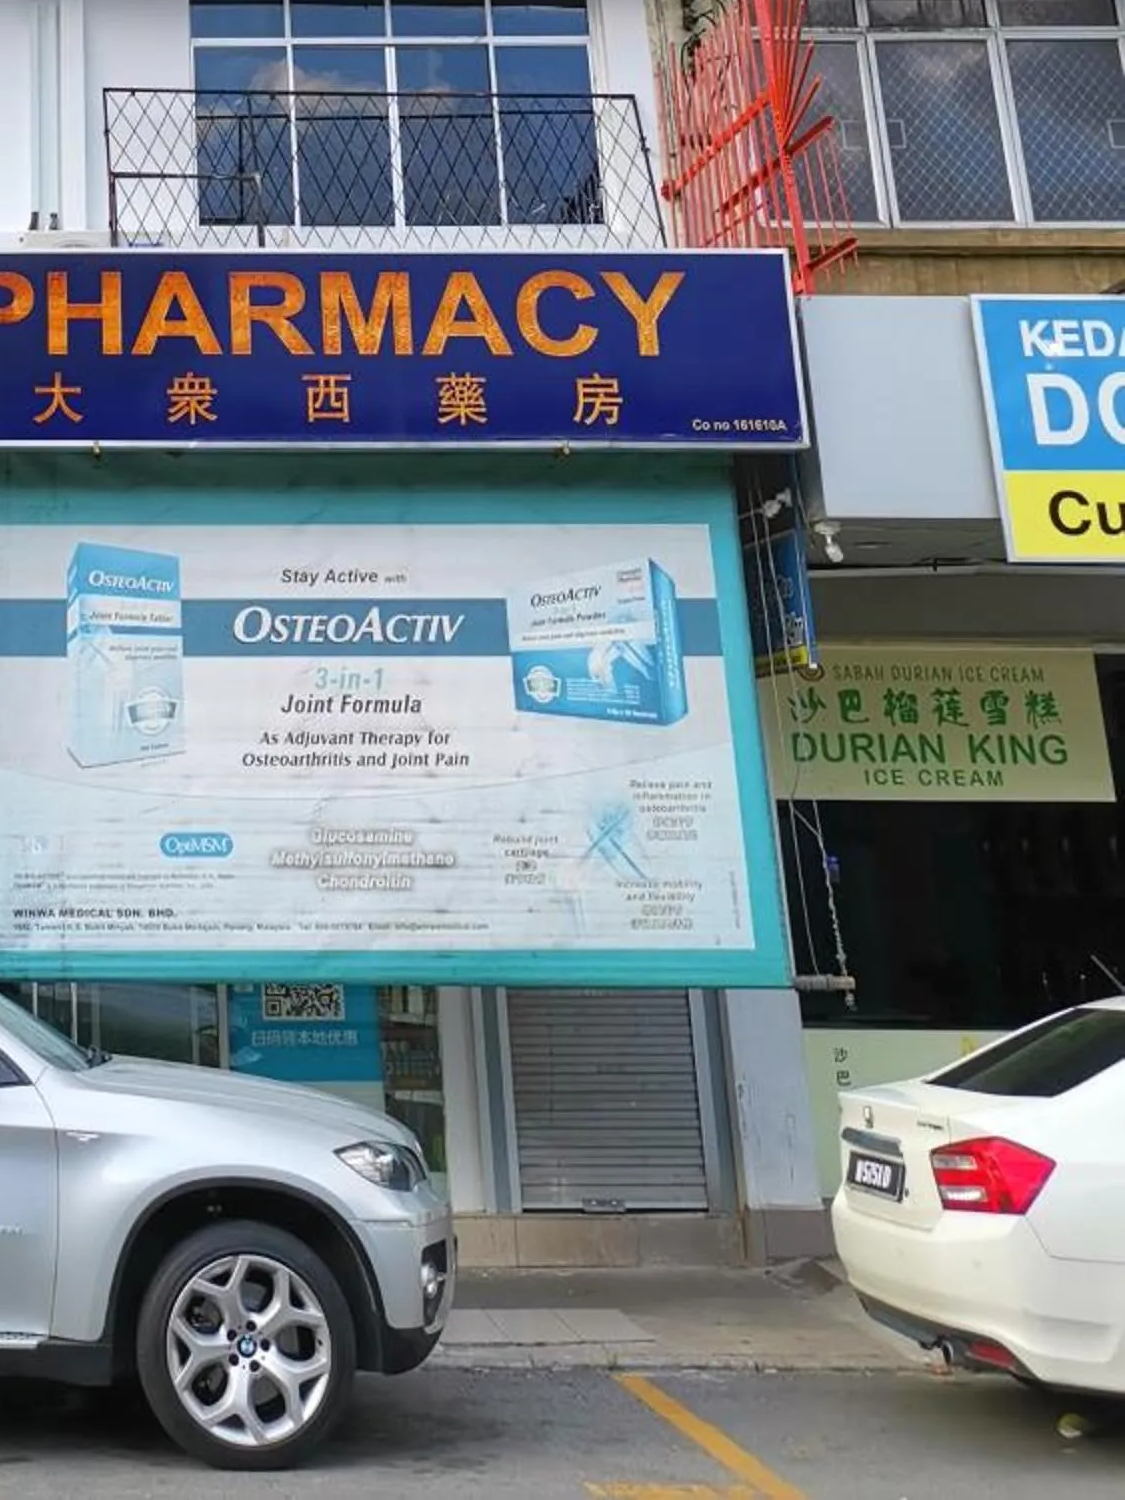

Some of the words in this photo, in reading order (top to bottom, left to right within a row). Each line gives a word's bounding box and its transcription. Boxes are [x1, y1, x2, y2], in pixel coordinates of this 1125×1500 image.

[1019, 319, 1125, 358] KED
[691, 417, 711, 432] Co
[714, 420, 730, 432] no
[281, 569, 319, 587] Stay
[324, 568, 379, 584] Active
[314, 666, 385, 691] 3-in-1
[832, 664, 884, 682] SABAH
[890, 664, 953, 683] DURIAN
[959, 665, 985, 682] ICE
[989, 665, 1045, 684] CREAM
[280, 694, 334, 714] Joint
[339, 694, 423, 714] Formula
[259, 731, 279, 746] As
[283, 730, 355, 748] Adjuvant
[359, 731, 423, 749] Therapy
[427, 729, 451, 746] for
[791, 731, 947, 764] DURIAN
[967, 732, 1069, 766] KING
[242, 751, 353, 767] Osteoarthritis
[356, 752, 387, 767] and
[435, 751, 471, 767] Pain
[864, 768, 905, 786] ICE
[918, 768, 1005, 788] CREAM
[311, 828, 415, 847] Glucosamine
[316, 873, 413, 891] Chondroitin
[12, 907, 56, 919] WINWA
[58, 907, 113, 919] MEDICAL
